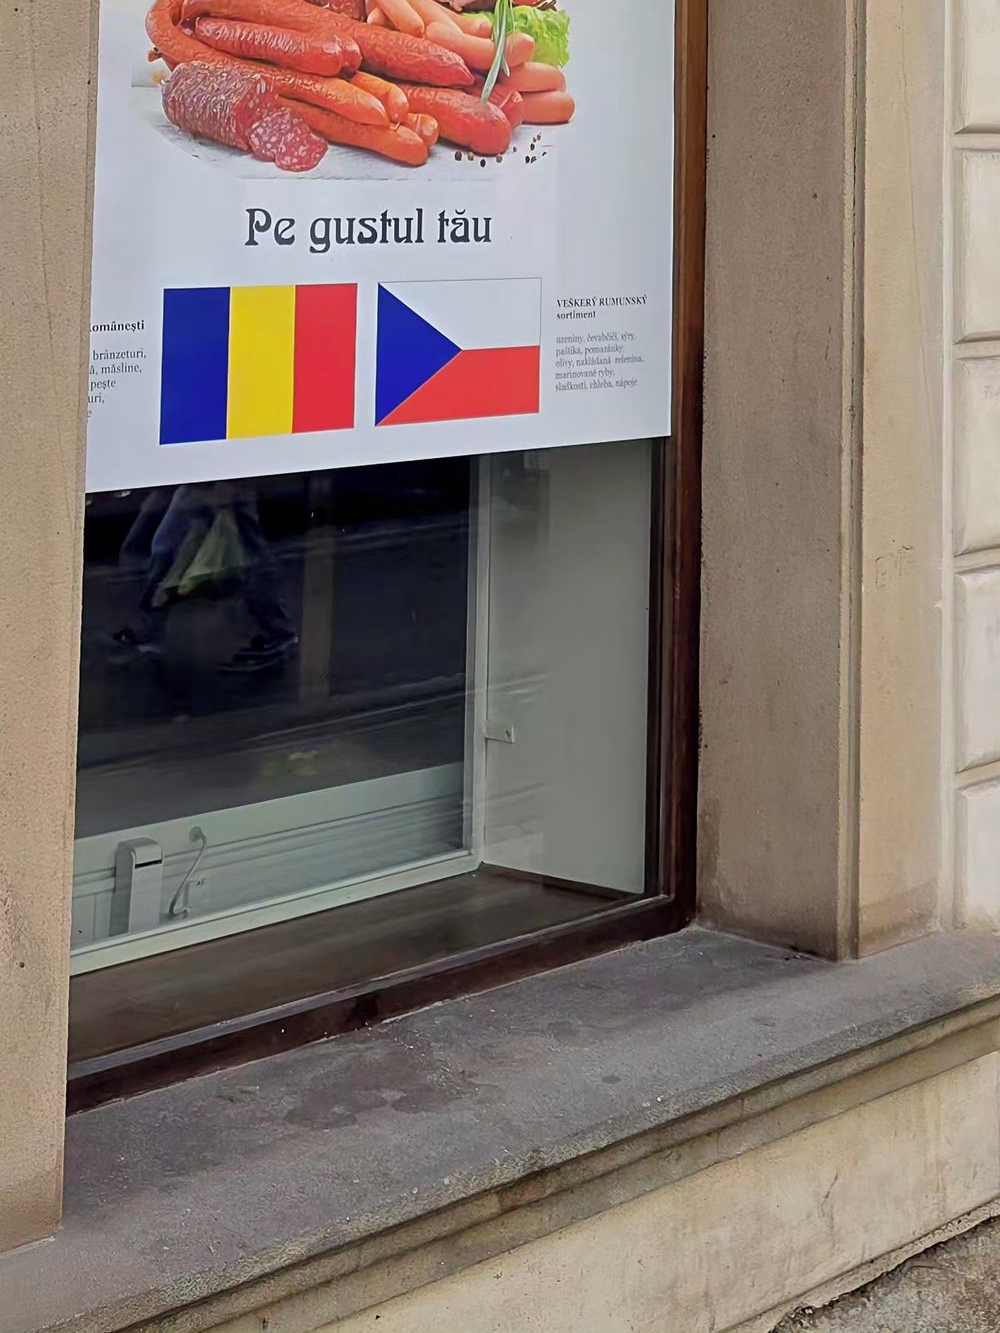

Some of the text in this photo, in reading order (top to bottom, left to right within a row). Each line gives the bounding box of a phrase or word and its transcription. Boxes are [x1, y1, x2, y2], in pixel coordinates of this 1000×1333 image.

[244, 208, 493, 254] Pe gustul tău
